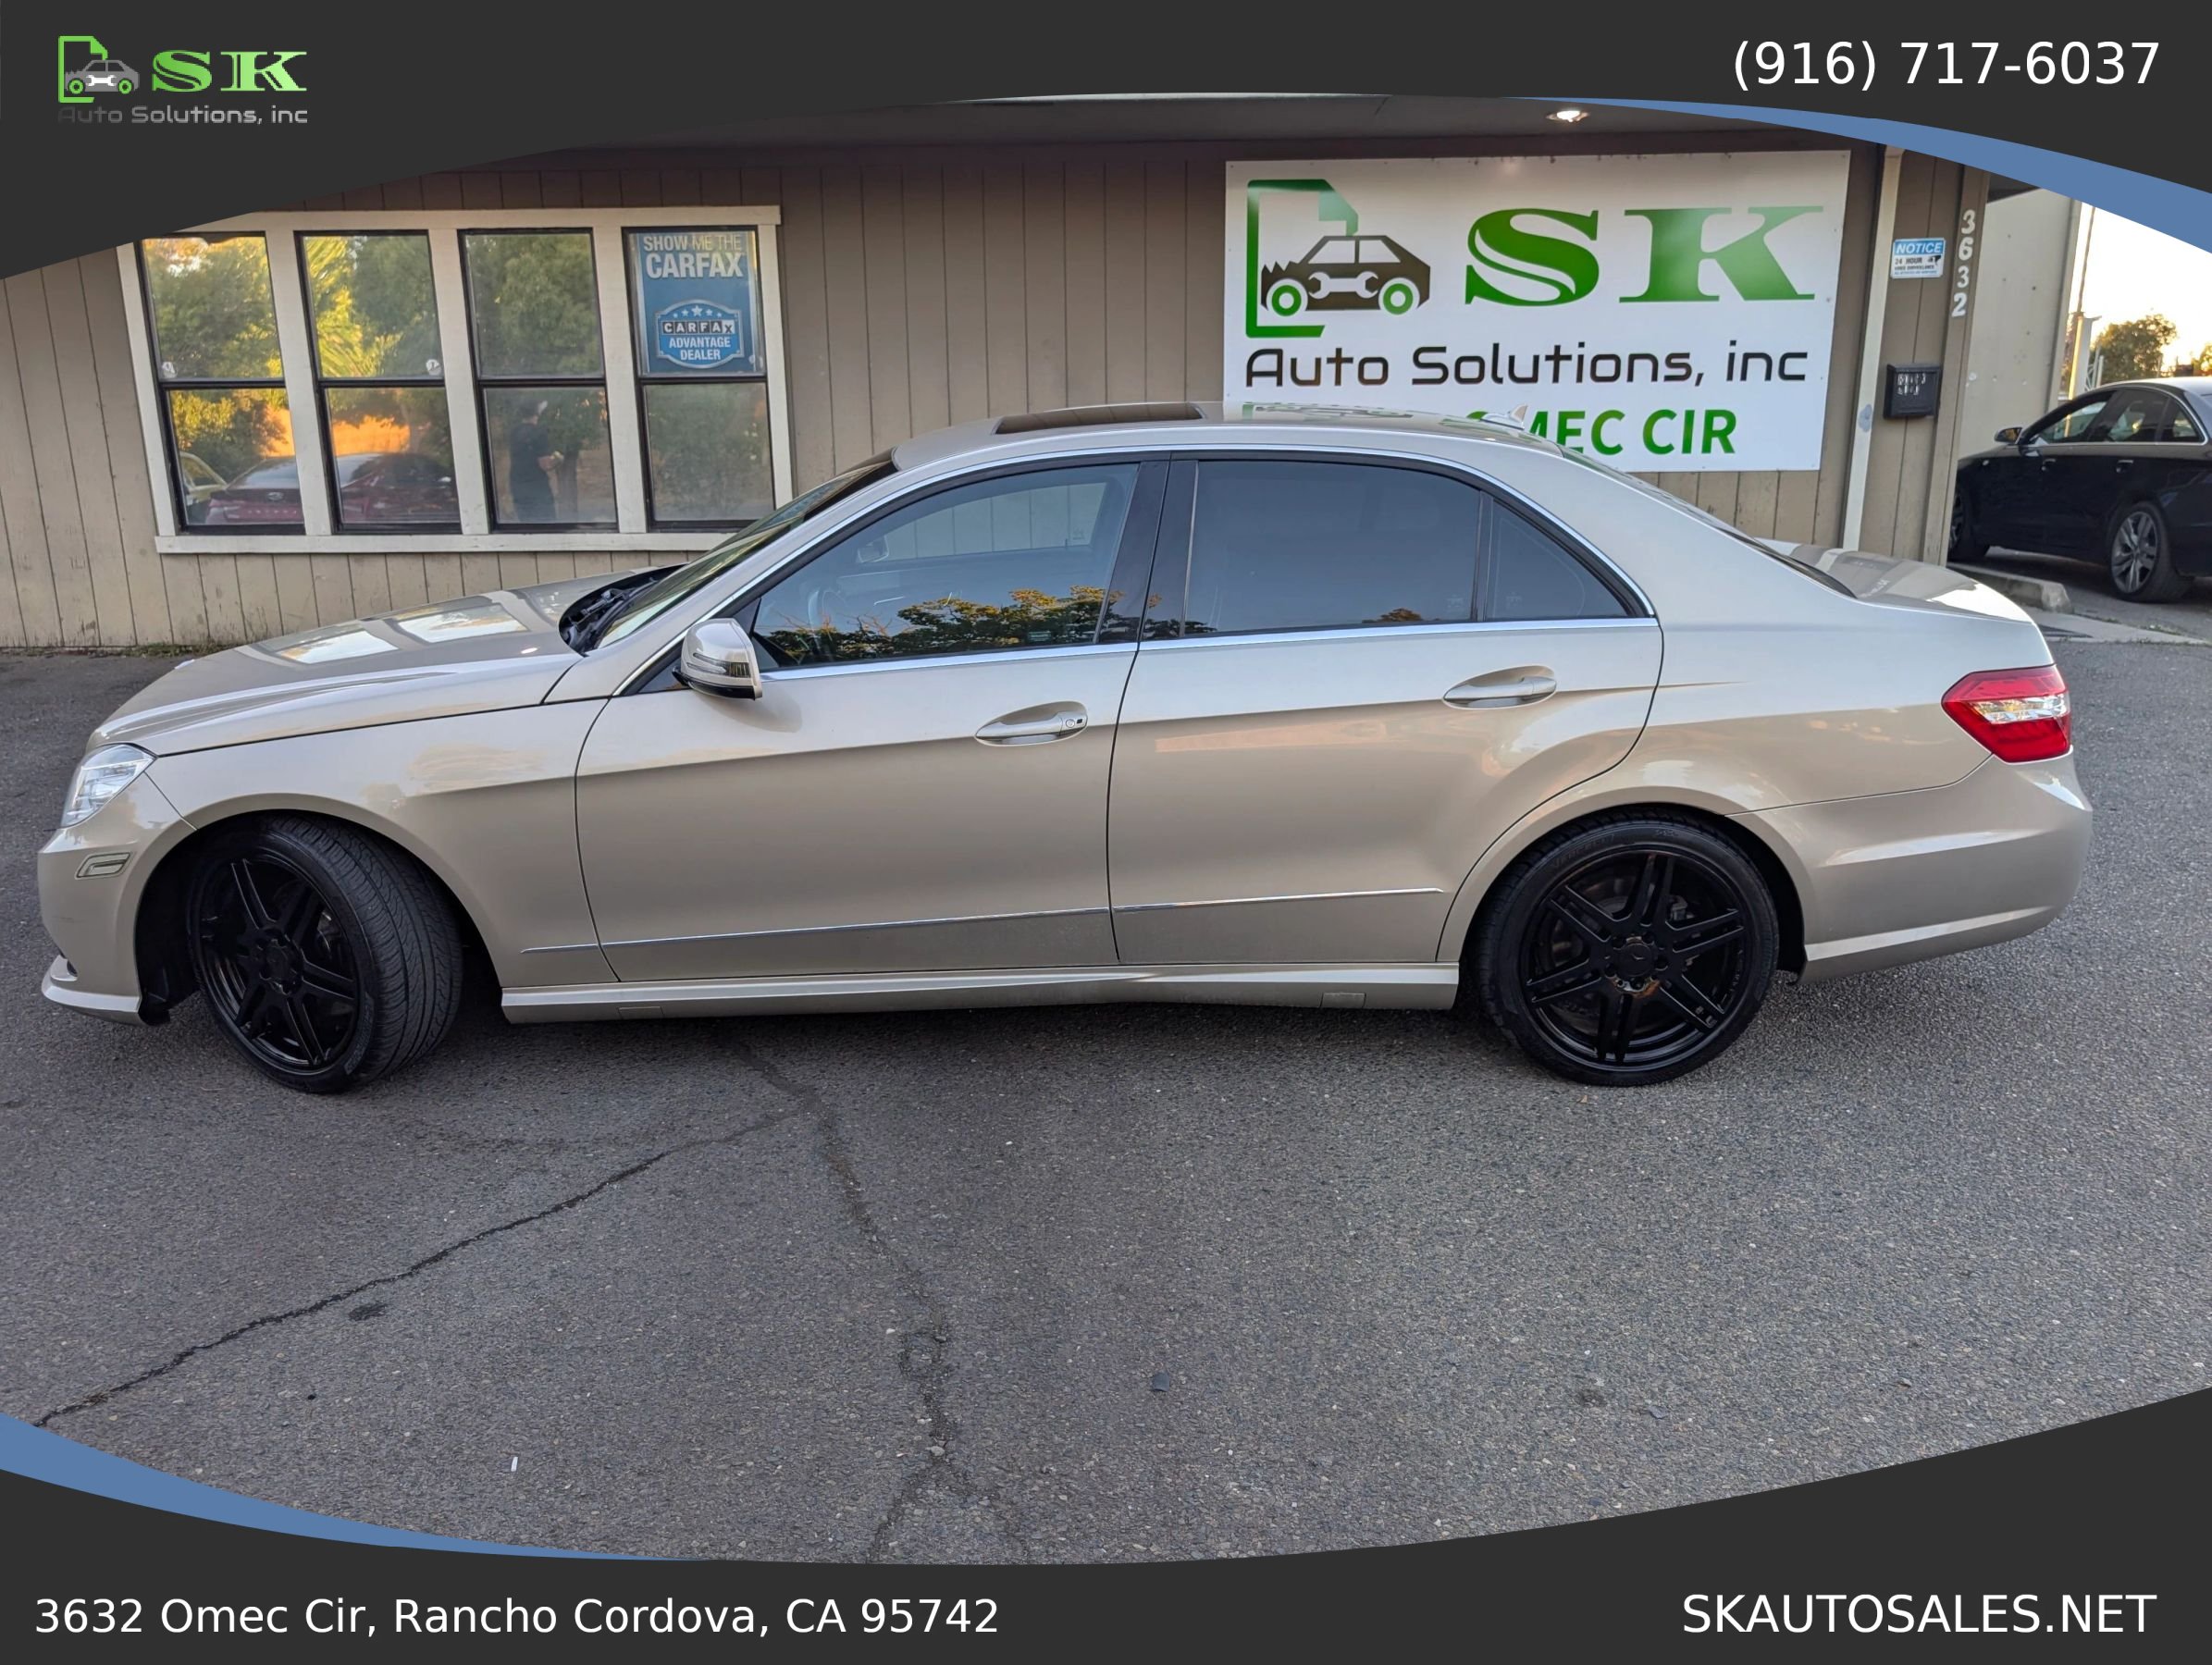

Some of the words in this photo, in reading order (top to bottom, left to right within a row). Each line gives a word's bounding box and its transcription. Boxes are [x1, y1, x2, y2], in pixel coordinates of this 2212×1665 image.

[643, 235, 688, 252] SHOW
[692, 235, 714, 251] ME
[717, 234, 743, 251] THE
[1897, 241, 1943, 254] NOTICE
[646, 252, 744, 278] CARFAX
[1464, 205, 1824, 307] SK
[663, 322, 734, 334] CARFAX
[669, 336, 732, 349] ADVANTAGE
[680, 349, 722, 361] DEALER
[1246, 348, 1389, 387] Auto
[1412, 342, 1704, 387] Solutions,
[1726, 340, 1808, 381] inc
[1465, 409, 1625, 456] EC
[1642, 408, 1738, 456] CIR
